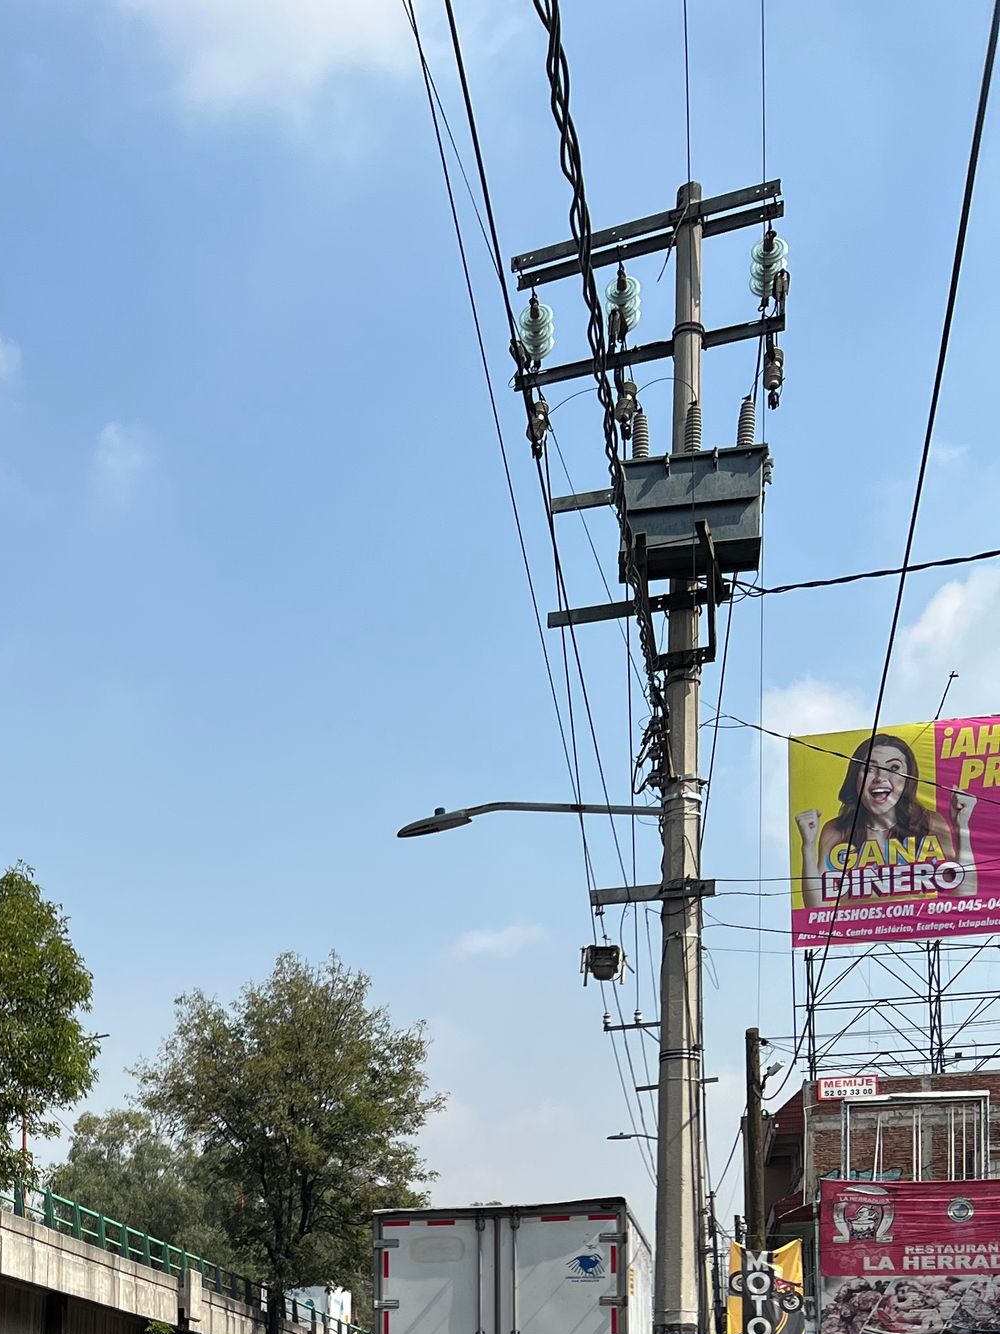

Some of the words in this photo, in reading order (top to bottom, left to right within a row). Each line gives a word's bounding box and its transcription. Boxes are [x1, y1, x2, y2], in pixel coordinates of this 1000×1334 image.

[959, 756, 1000, 790] PR
[829, 835, 946, 870] GANA
[825, 861, 965, 900] DINERO
[846, 926, 873, 937] Centro
[824, 1078, 873, 1088] MEMIJE
[904, 1244, 1000, 1254] RESTAURAN
[863, 1256, 895, 1271] LA
